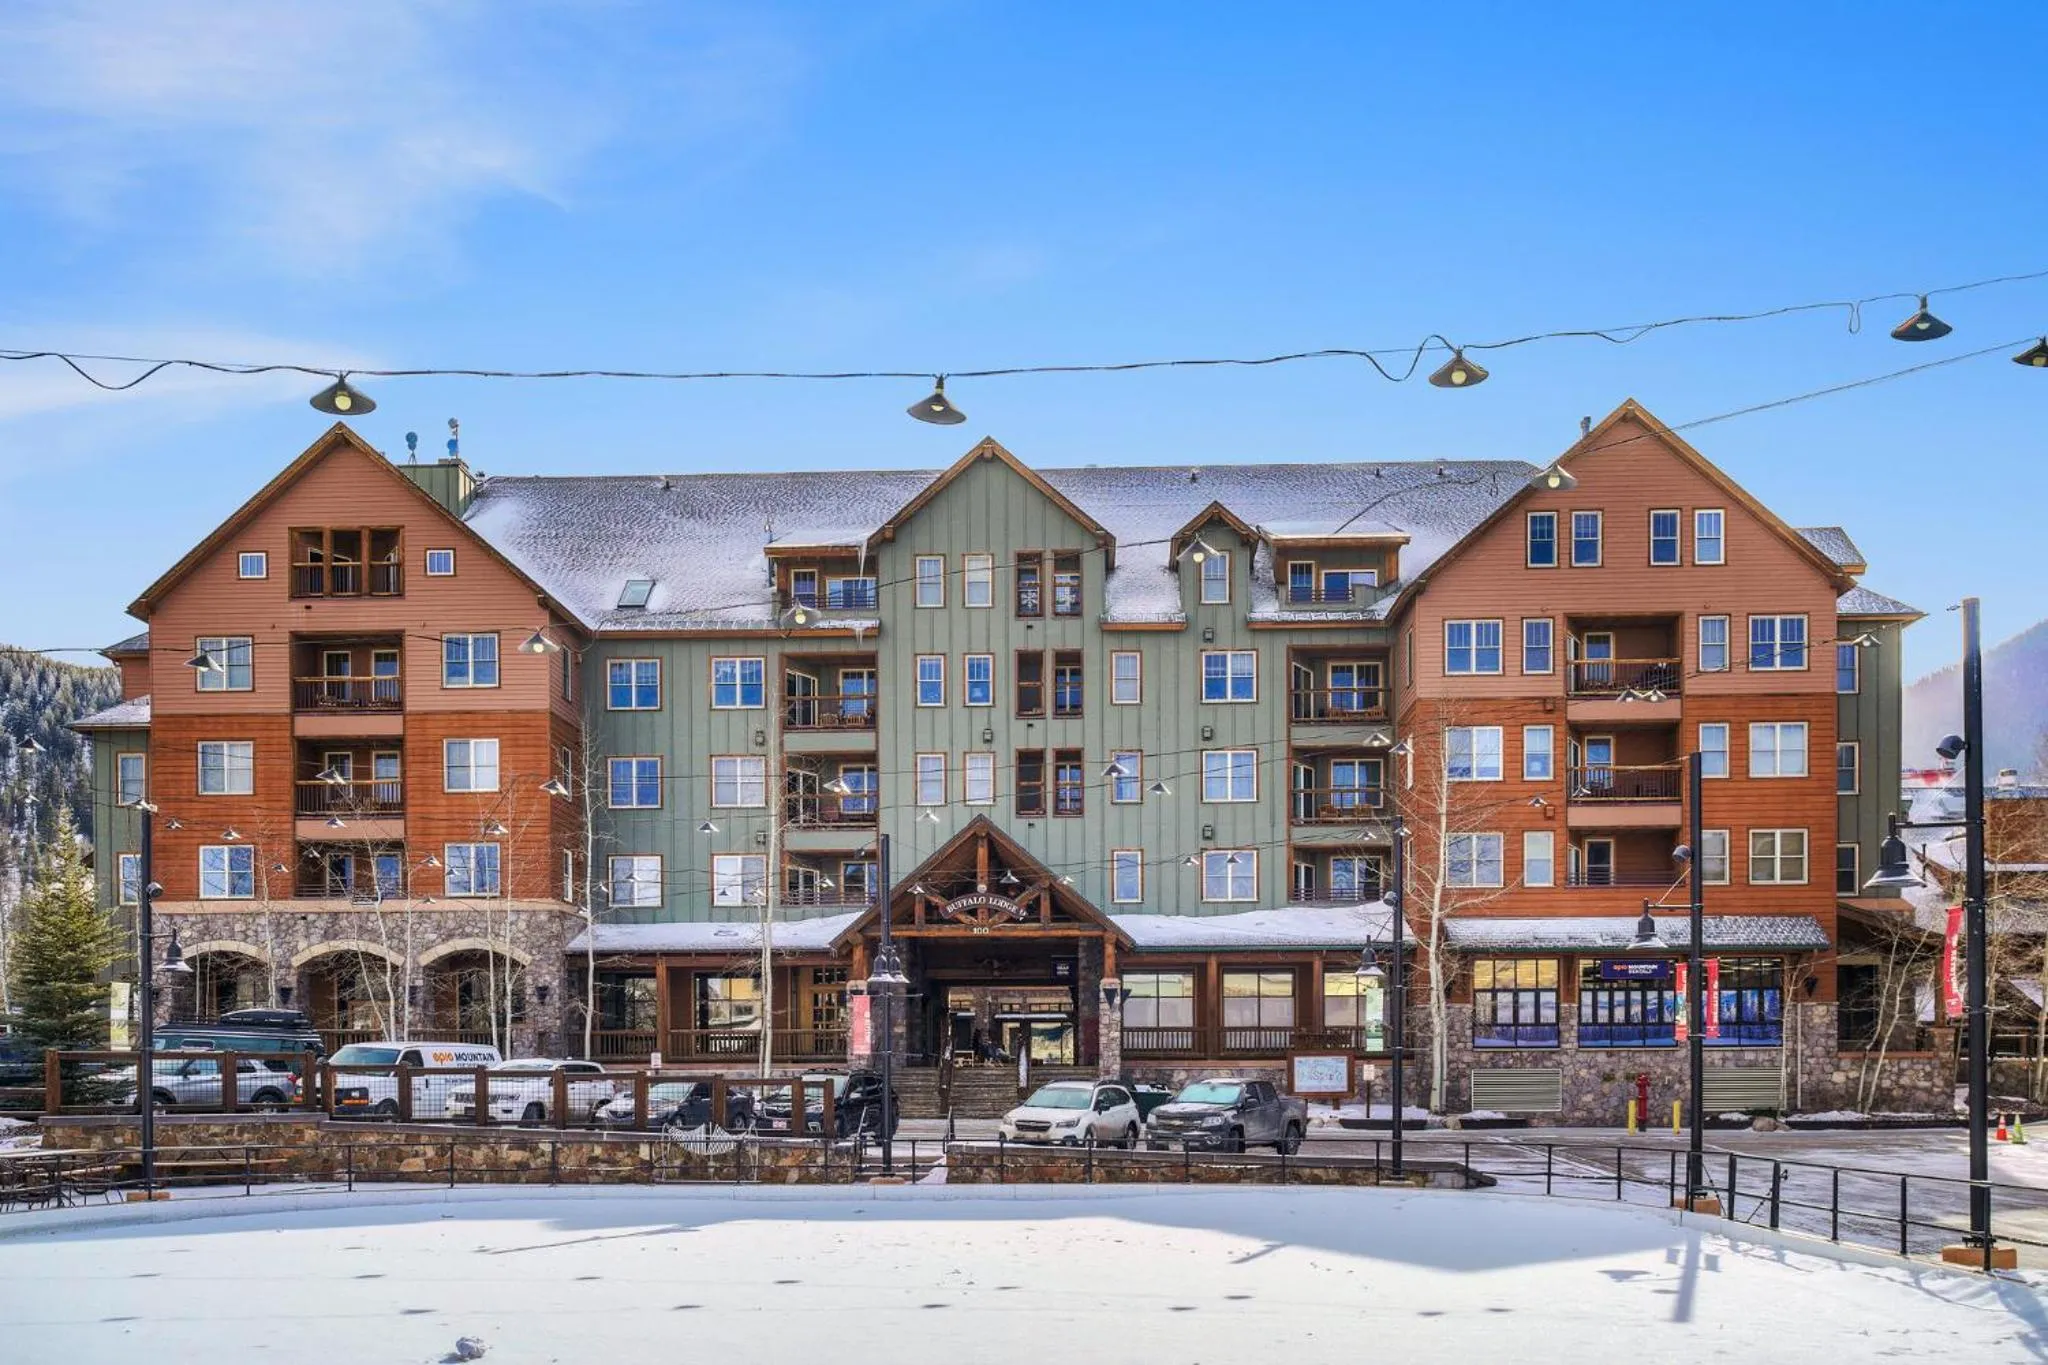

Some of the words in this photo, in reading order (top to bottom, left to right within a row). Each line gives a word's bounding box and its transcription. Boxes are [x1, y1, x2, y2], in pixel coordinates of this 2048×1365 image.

[946, 896, 986, 913] BUFFALO
[989, 896, 1018, 914] LODGE
[455, 1052, 495, 1061] MOUNTAIN
